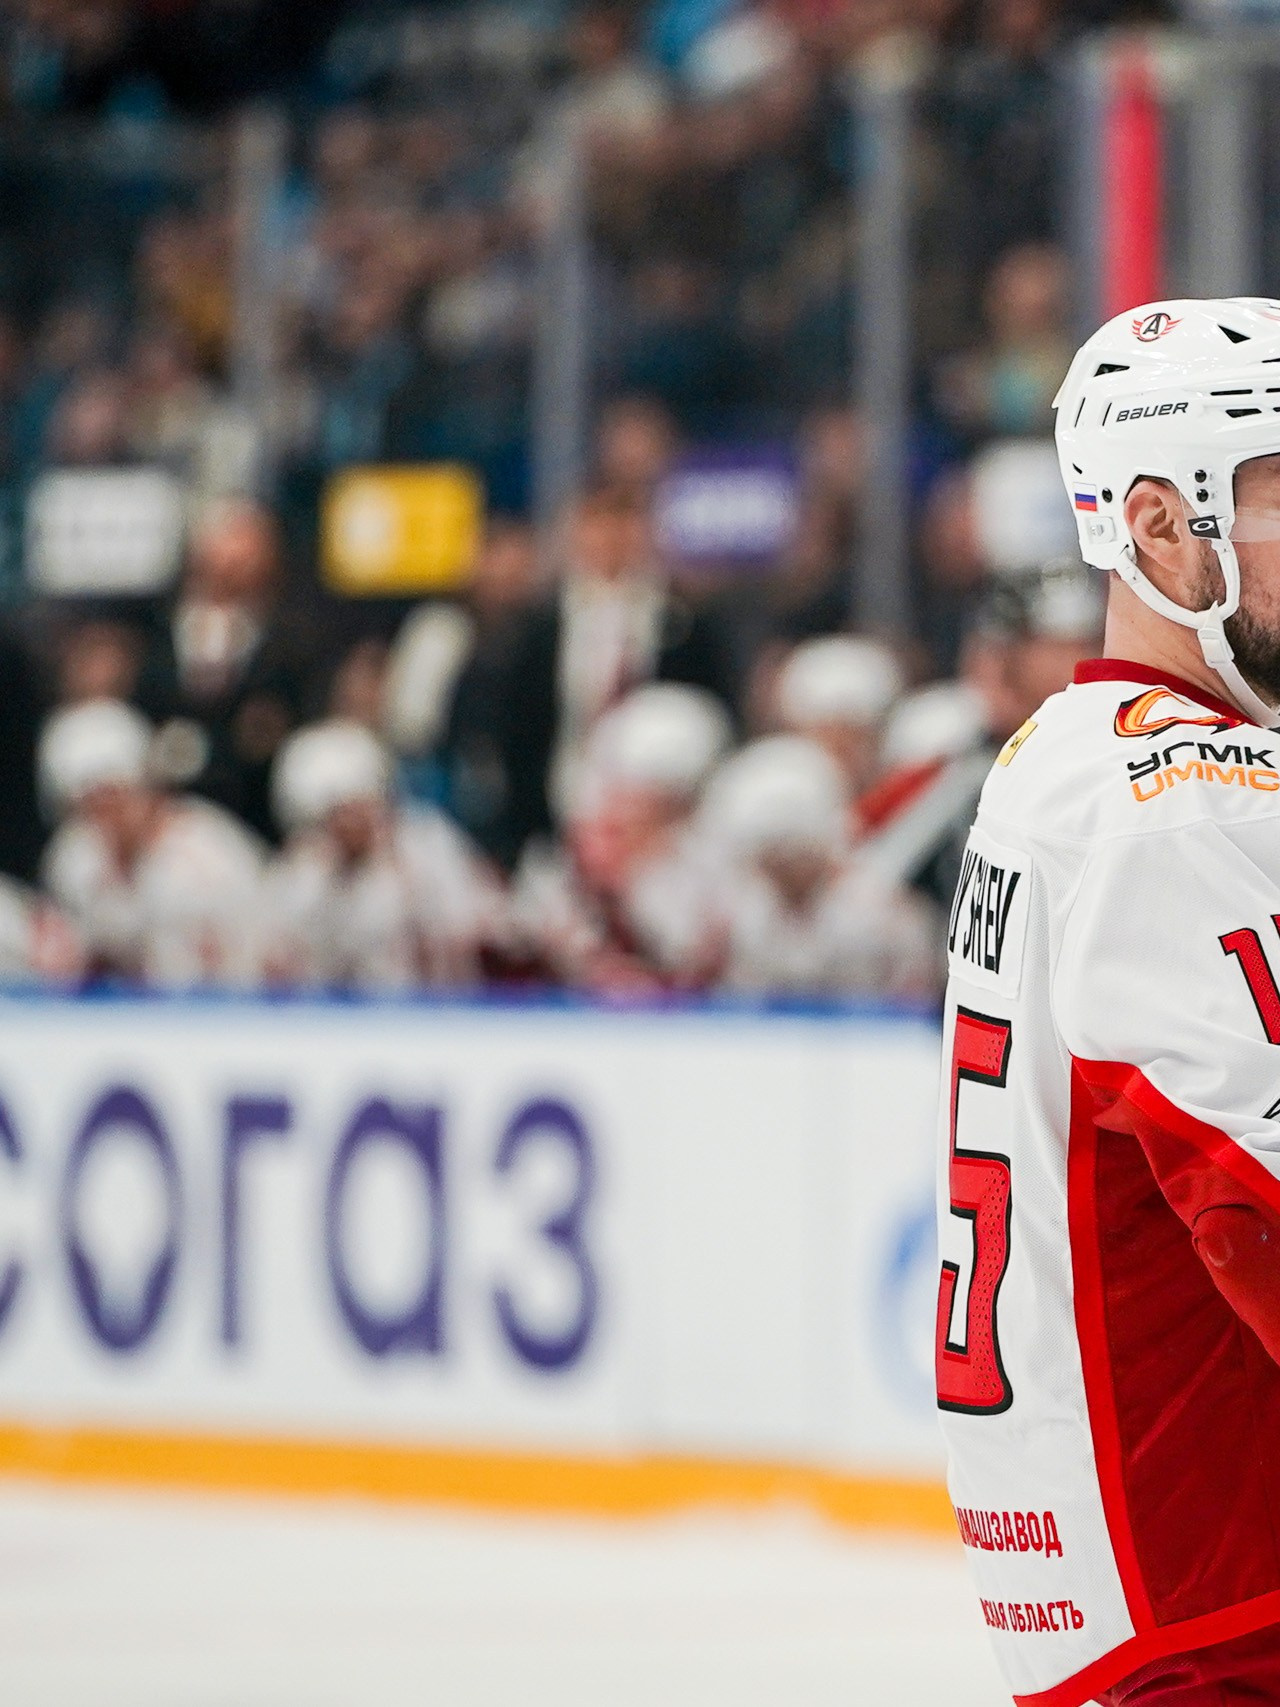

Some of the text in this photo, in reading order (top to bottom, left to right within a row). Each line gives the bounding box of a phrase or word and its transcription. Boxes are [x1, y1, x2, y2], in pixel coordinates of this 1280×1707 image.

[1115, 401, 1189, 423] BAUER
[1127, 741, 1276, 781] УГМК
[1131, 760, 1280, 802] UMMC
[0, 1080, 600, 1374] огаз
[1008, 1600, 1084, 1633] ОБЛАСТЬ
